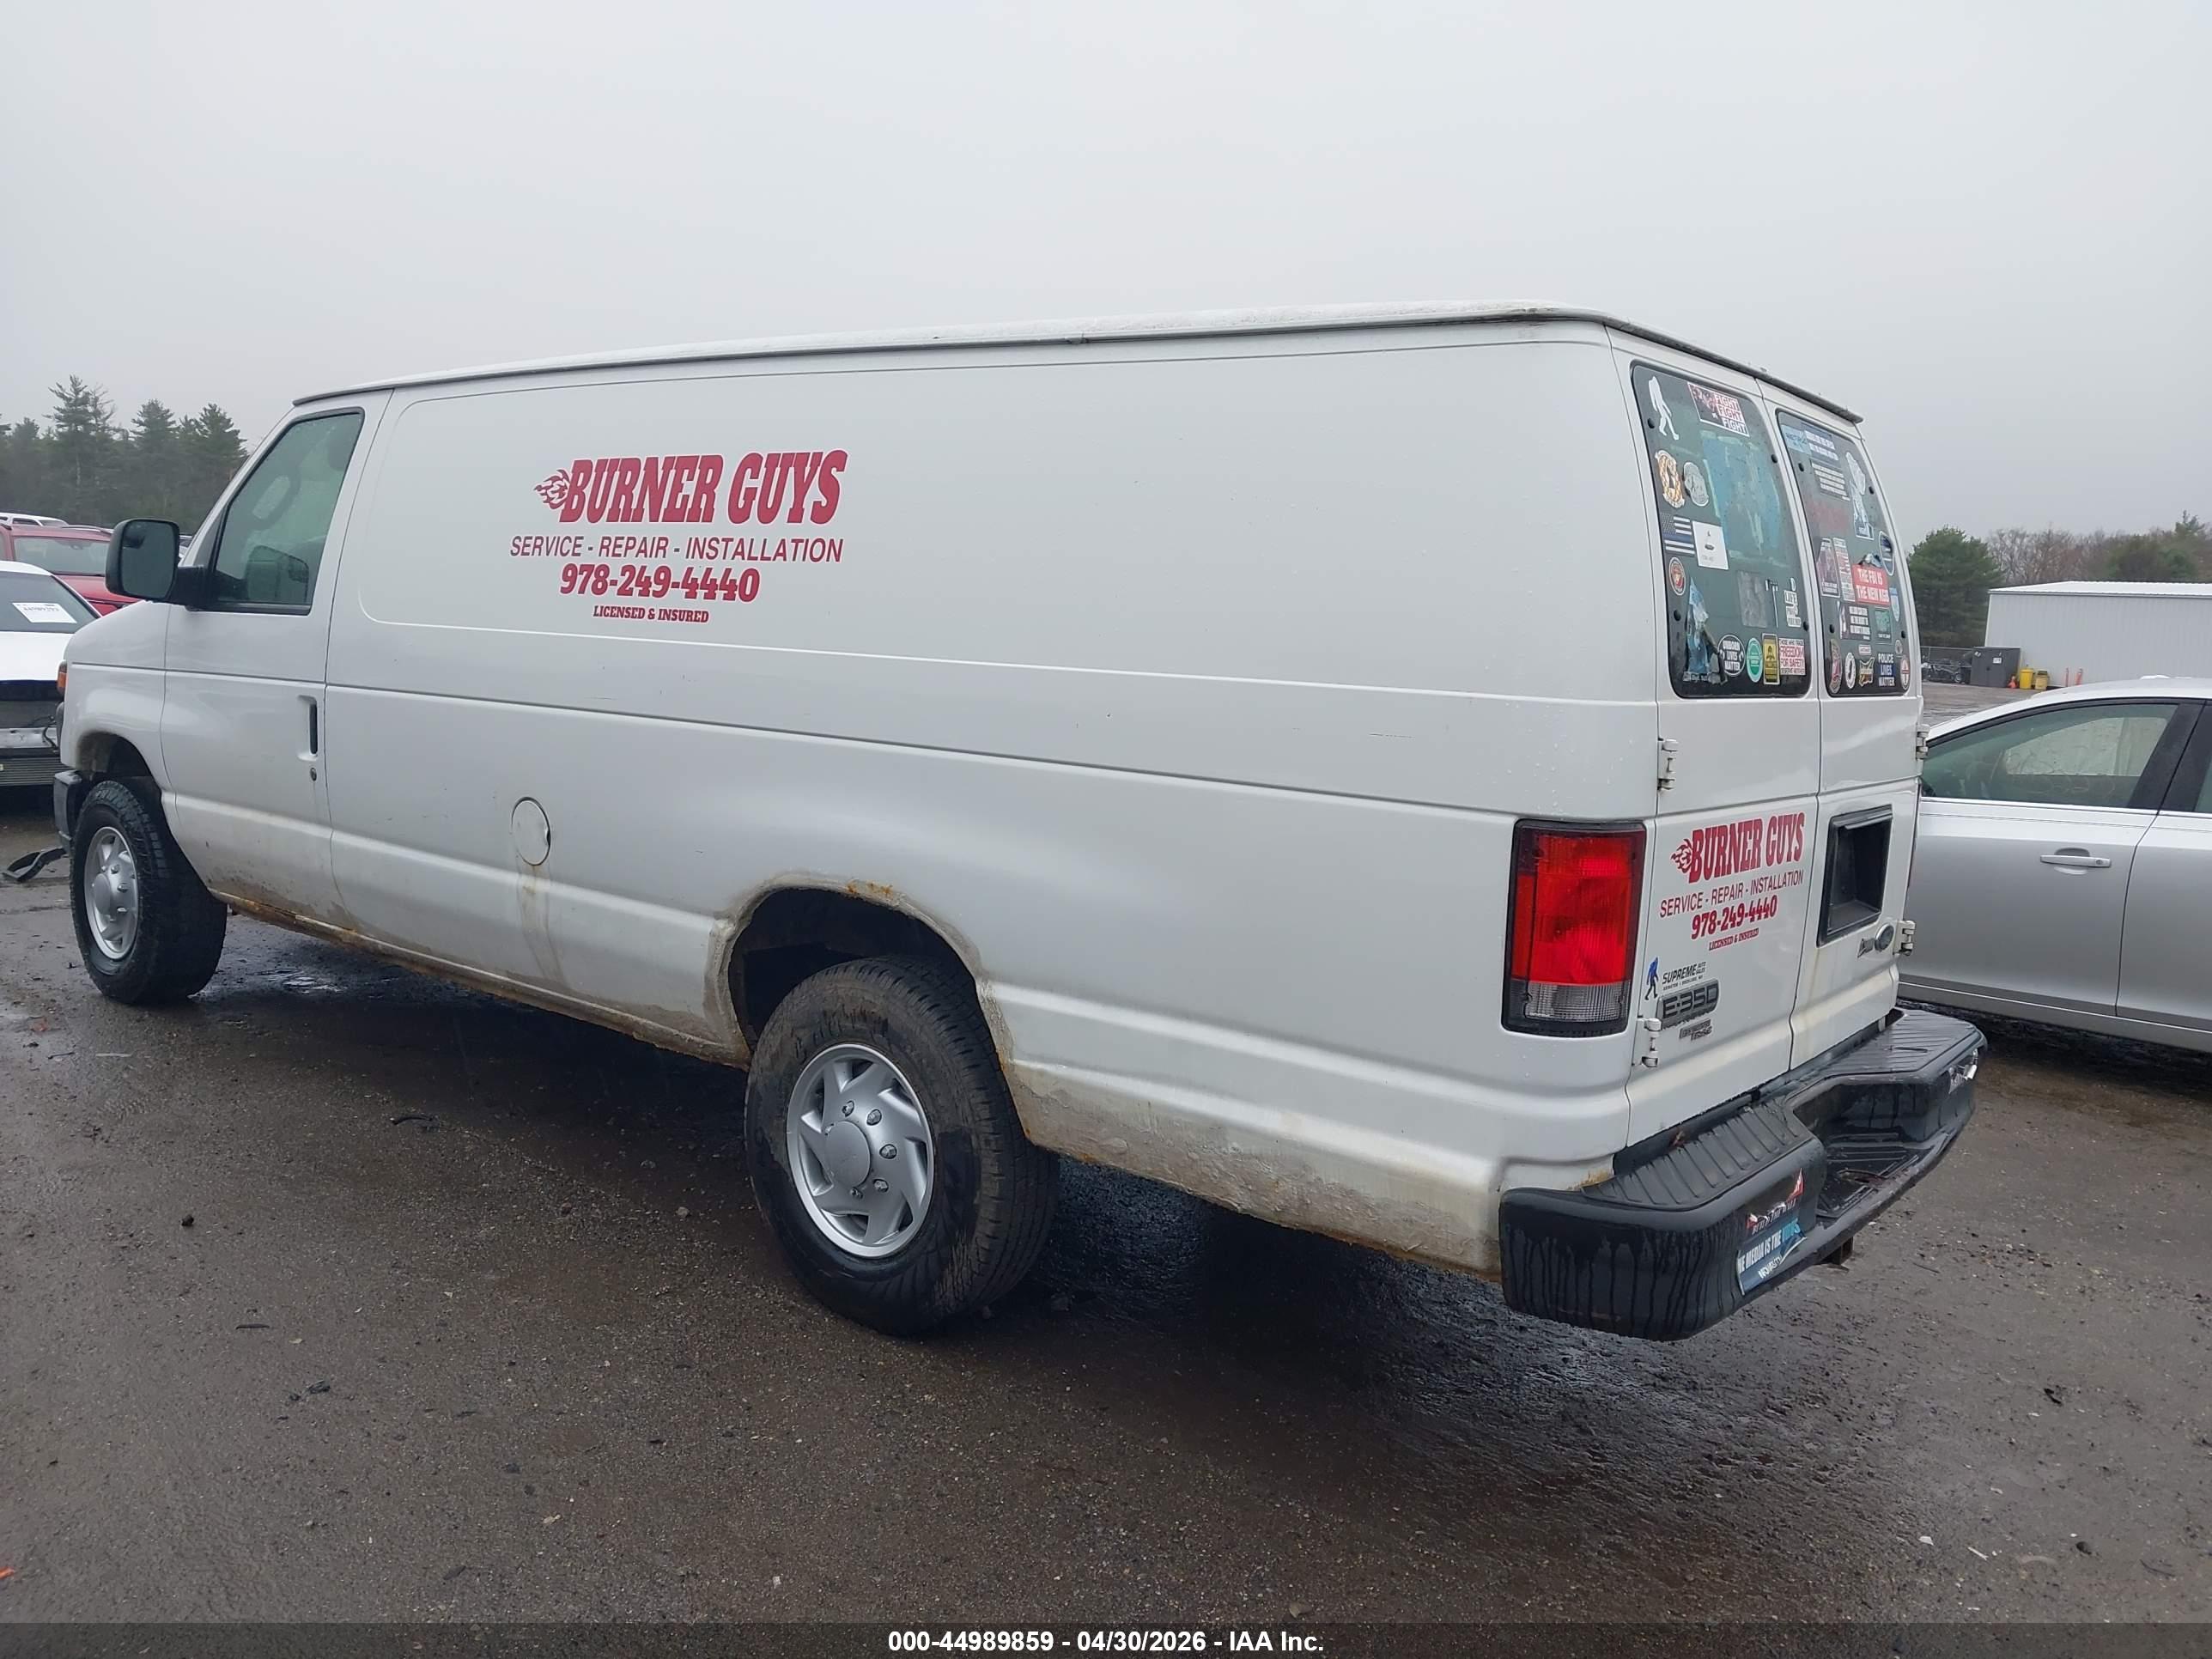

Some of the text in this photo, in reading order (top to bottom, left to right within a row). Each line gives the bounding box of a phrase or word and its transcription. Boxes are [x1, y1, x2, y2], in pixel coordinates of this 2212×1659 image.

[1715, 393, 1738, 410] FIGHT
[1717, 405, 1744, 422] FIGHT
[1722, 417, 1747, 434] FIGHT
[559, 449, 848, 525] BURNER GUYS
[510, 535, 585, 557] SERVICE
[598, 536, 670, 559] REPAIR
[685, 537, 844, 563] INSTALLATION
[559, 562, 761, 603] 978-249-4440
[592, 605, 710, 623] LICENSED & INSURED
[1878, 653, 1894, 664] POLICE
[1881, 665, 1893, 676] LIVES
[1878, 677, 1895, 687] MATTER
[1689, 812, 1806, 884] BURNER GUYS
[1660, 892, 1705, 919] SERVICE
[1712, 882, 1744, 905] REPAIR
[1750, 869, 1804, 896] INSTALLATION
[1692, 895, 1778, 940] 978-249-4440
[1662, 963, 1697, 985] SUPREME
[1745, 1242, 1765, 1269] MEDIA
[1765, 1237, 1771, 1255] IS
[1771, 1229, 1782, 1250] THE
